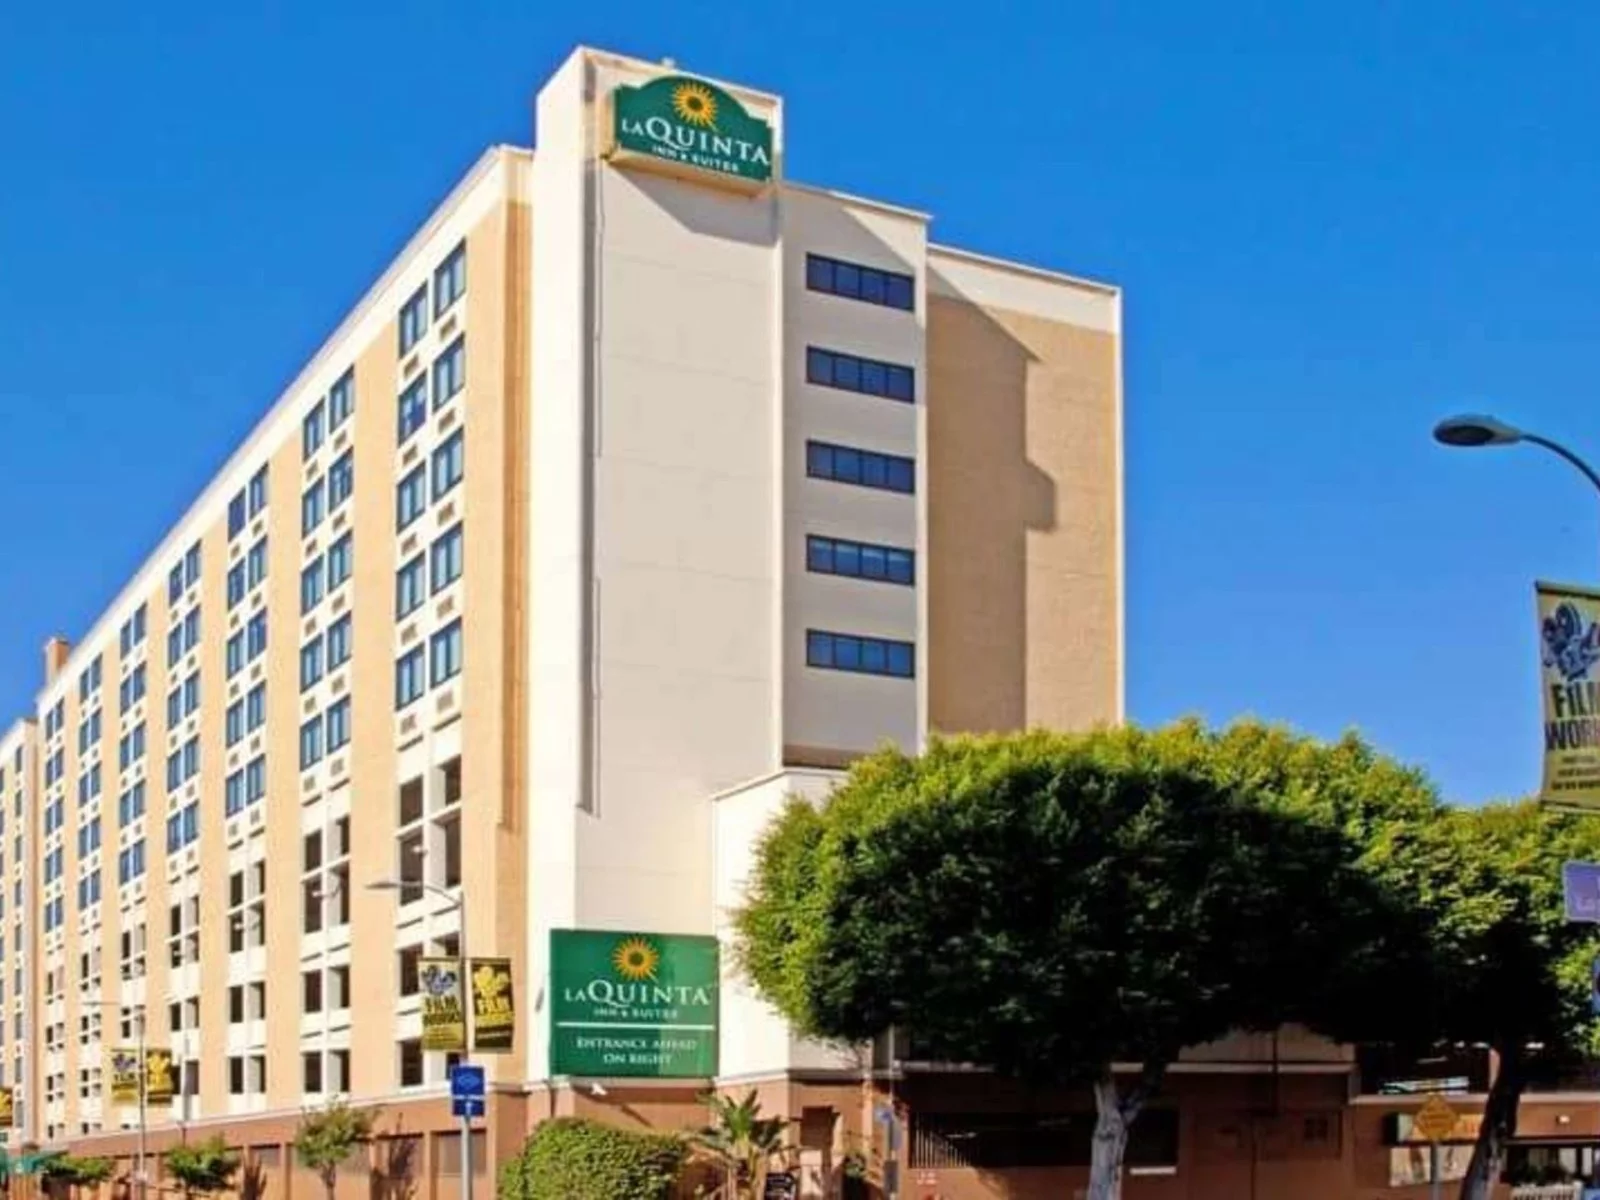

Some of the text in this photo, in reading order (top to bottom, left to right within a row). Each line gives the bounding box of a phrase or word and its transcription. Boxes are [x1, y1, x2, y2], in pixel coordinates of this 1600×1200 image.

[622, 116, 770, 166] LA QUINTA
[564, 979, 710, 1008] LA QUINTA
[576, 1036, 646, 1050] ENTRANCE
[603, 1053, 672, 1065] ON RIGHT
